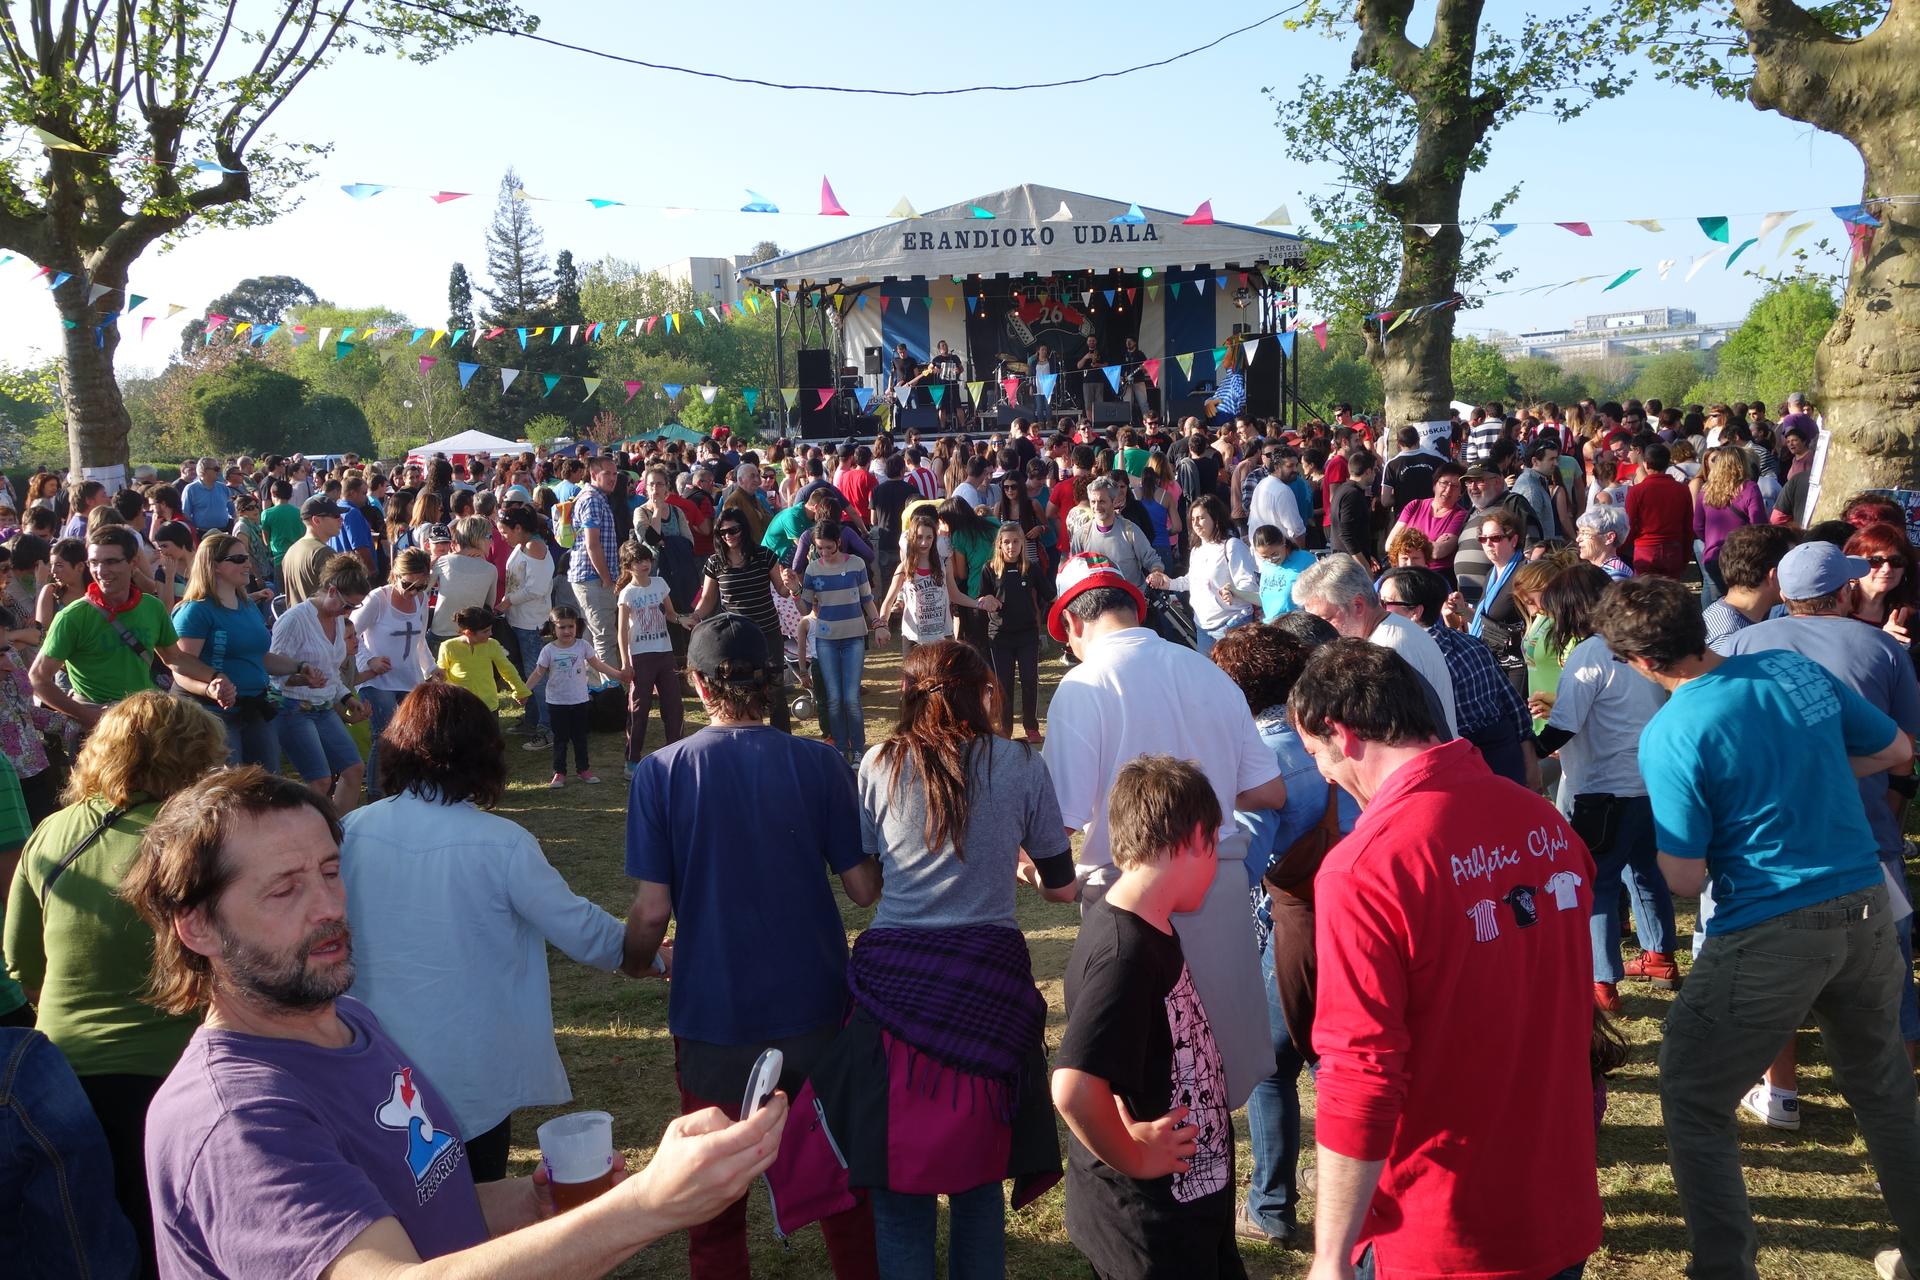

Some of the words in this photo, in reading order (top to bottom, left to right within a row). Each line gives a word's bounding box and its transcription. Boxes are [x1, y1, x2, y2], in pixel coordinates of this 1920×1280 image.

[903, 227, 1055, 250] ERANDIOKO
[1073, 223, 1159, 244] UDALA
[1040, 305, 1063, 324] 26
[1450, 844, 1521, 886] Athletic
[1527, 824, 1568, 862] Club
